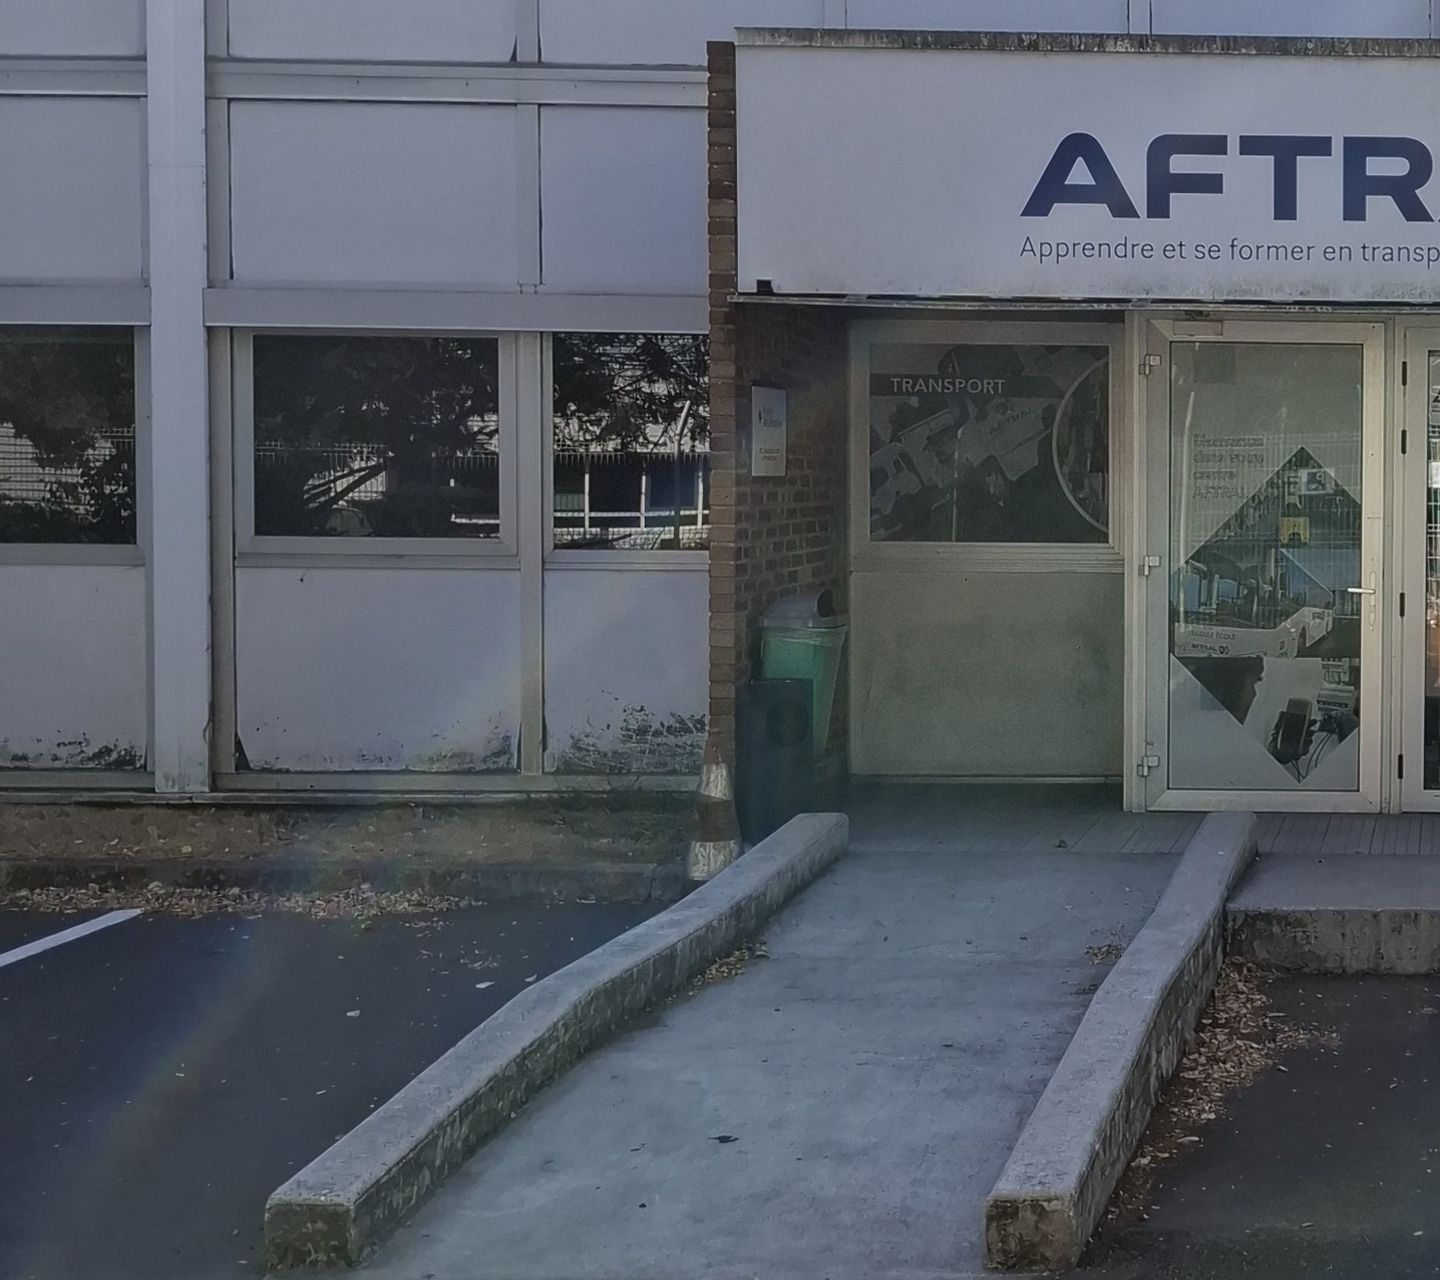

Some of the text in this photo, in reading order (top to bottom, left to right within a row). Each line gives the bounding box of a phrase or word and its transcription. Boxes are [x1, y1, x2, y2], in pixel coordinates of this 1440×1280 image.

[1019, 235, 1155, 265] Apprendre
[1162, 239, 1187, 261] et
[1194, 242, 1222, 261] se
[1229, 237, 1316, 262] former
[1322, 243, 1353, 263] en
[890, 377, 1006, 395] TRANSPORT
